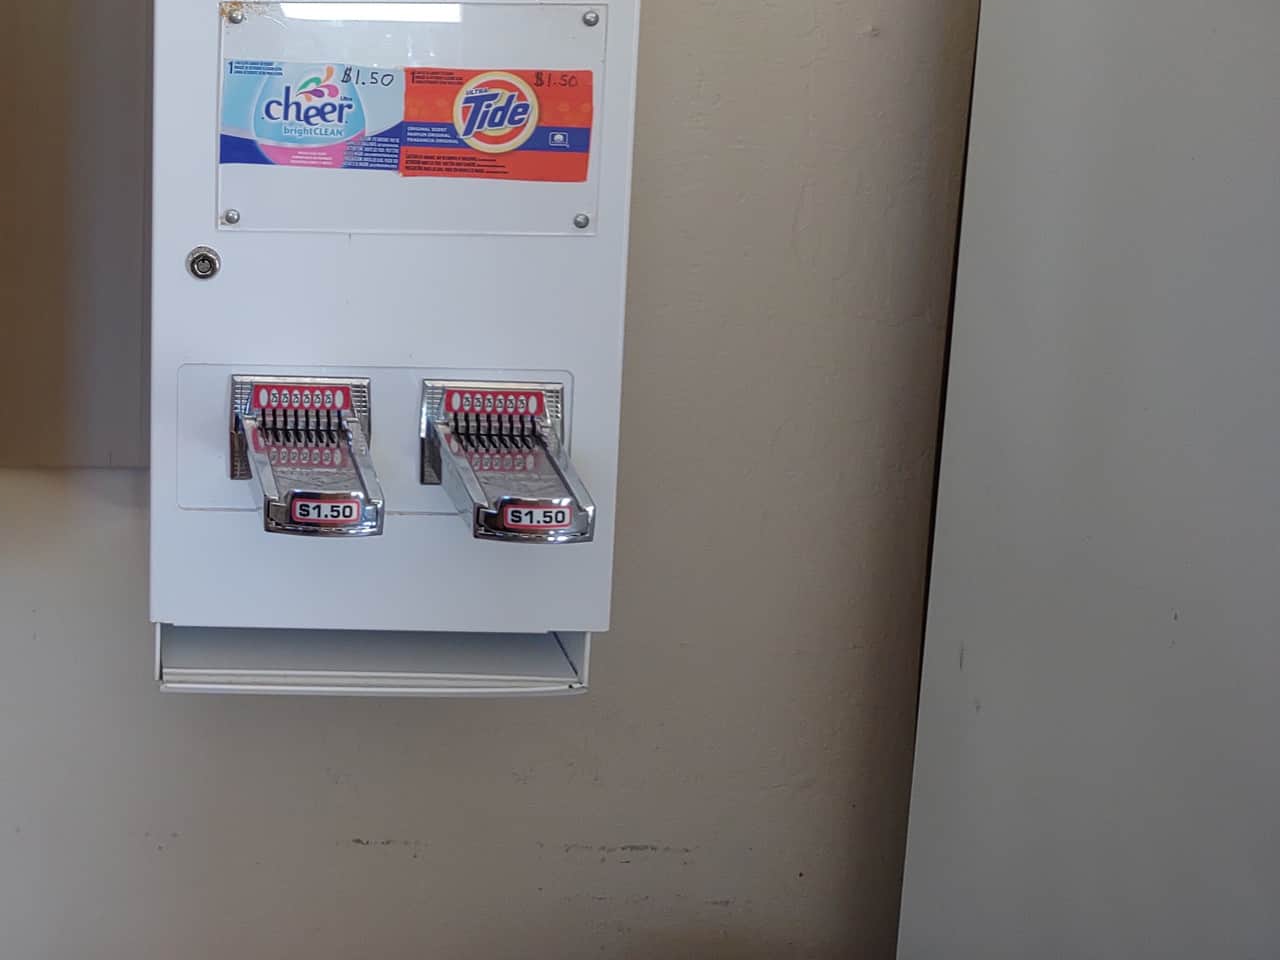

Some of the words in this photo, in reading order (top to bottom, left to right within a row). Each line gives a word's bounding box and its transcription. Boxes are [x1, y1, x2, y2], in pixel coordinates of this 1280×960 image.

[340, 64, 395, 87] $1.50
[533, 71, 579, 88] $1.50
[264, 85, 353, 126] cheer
[461, 92, 530, 138] Tide
[283, 126, 344, 137] brightCLEAN
